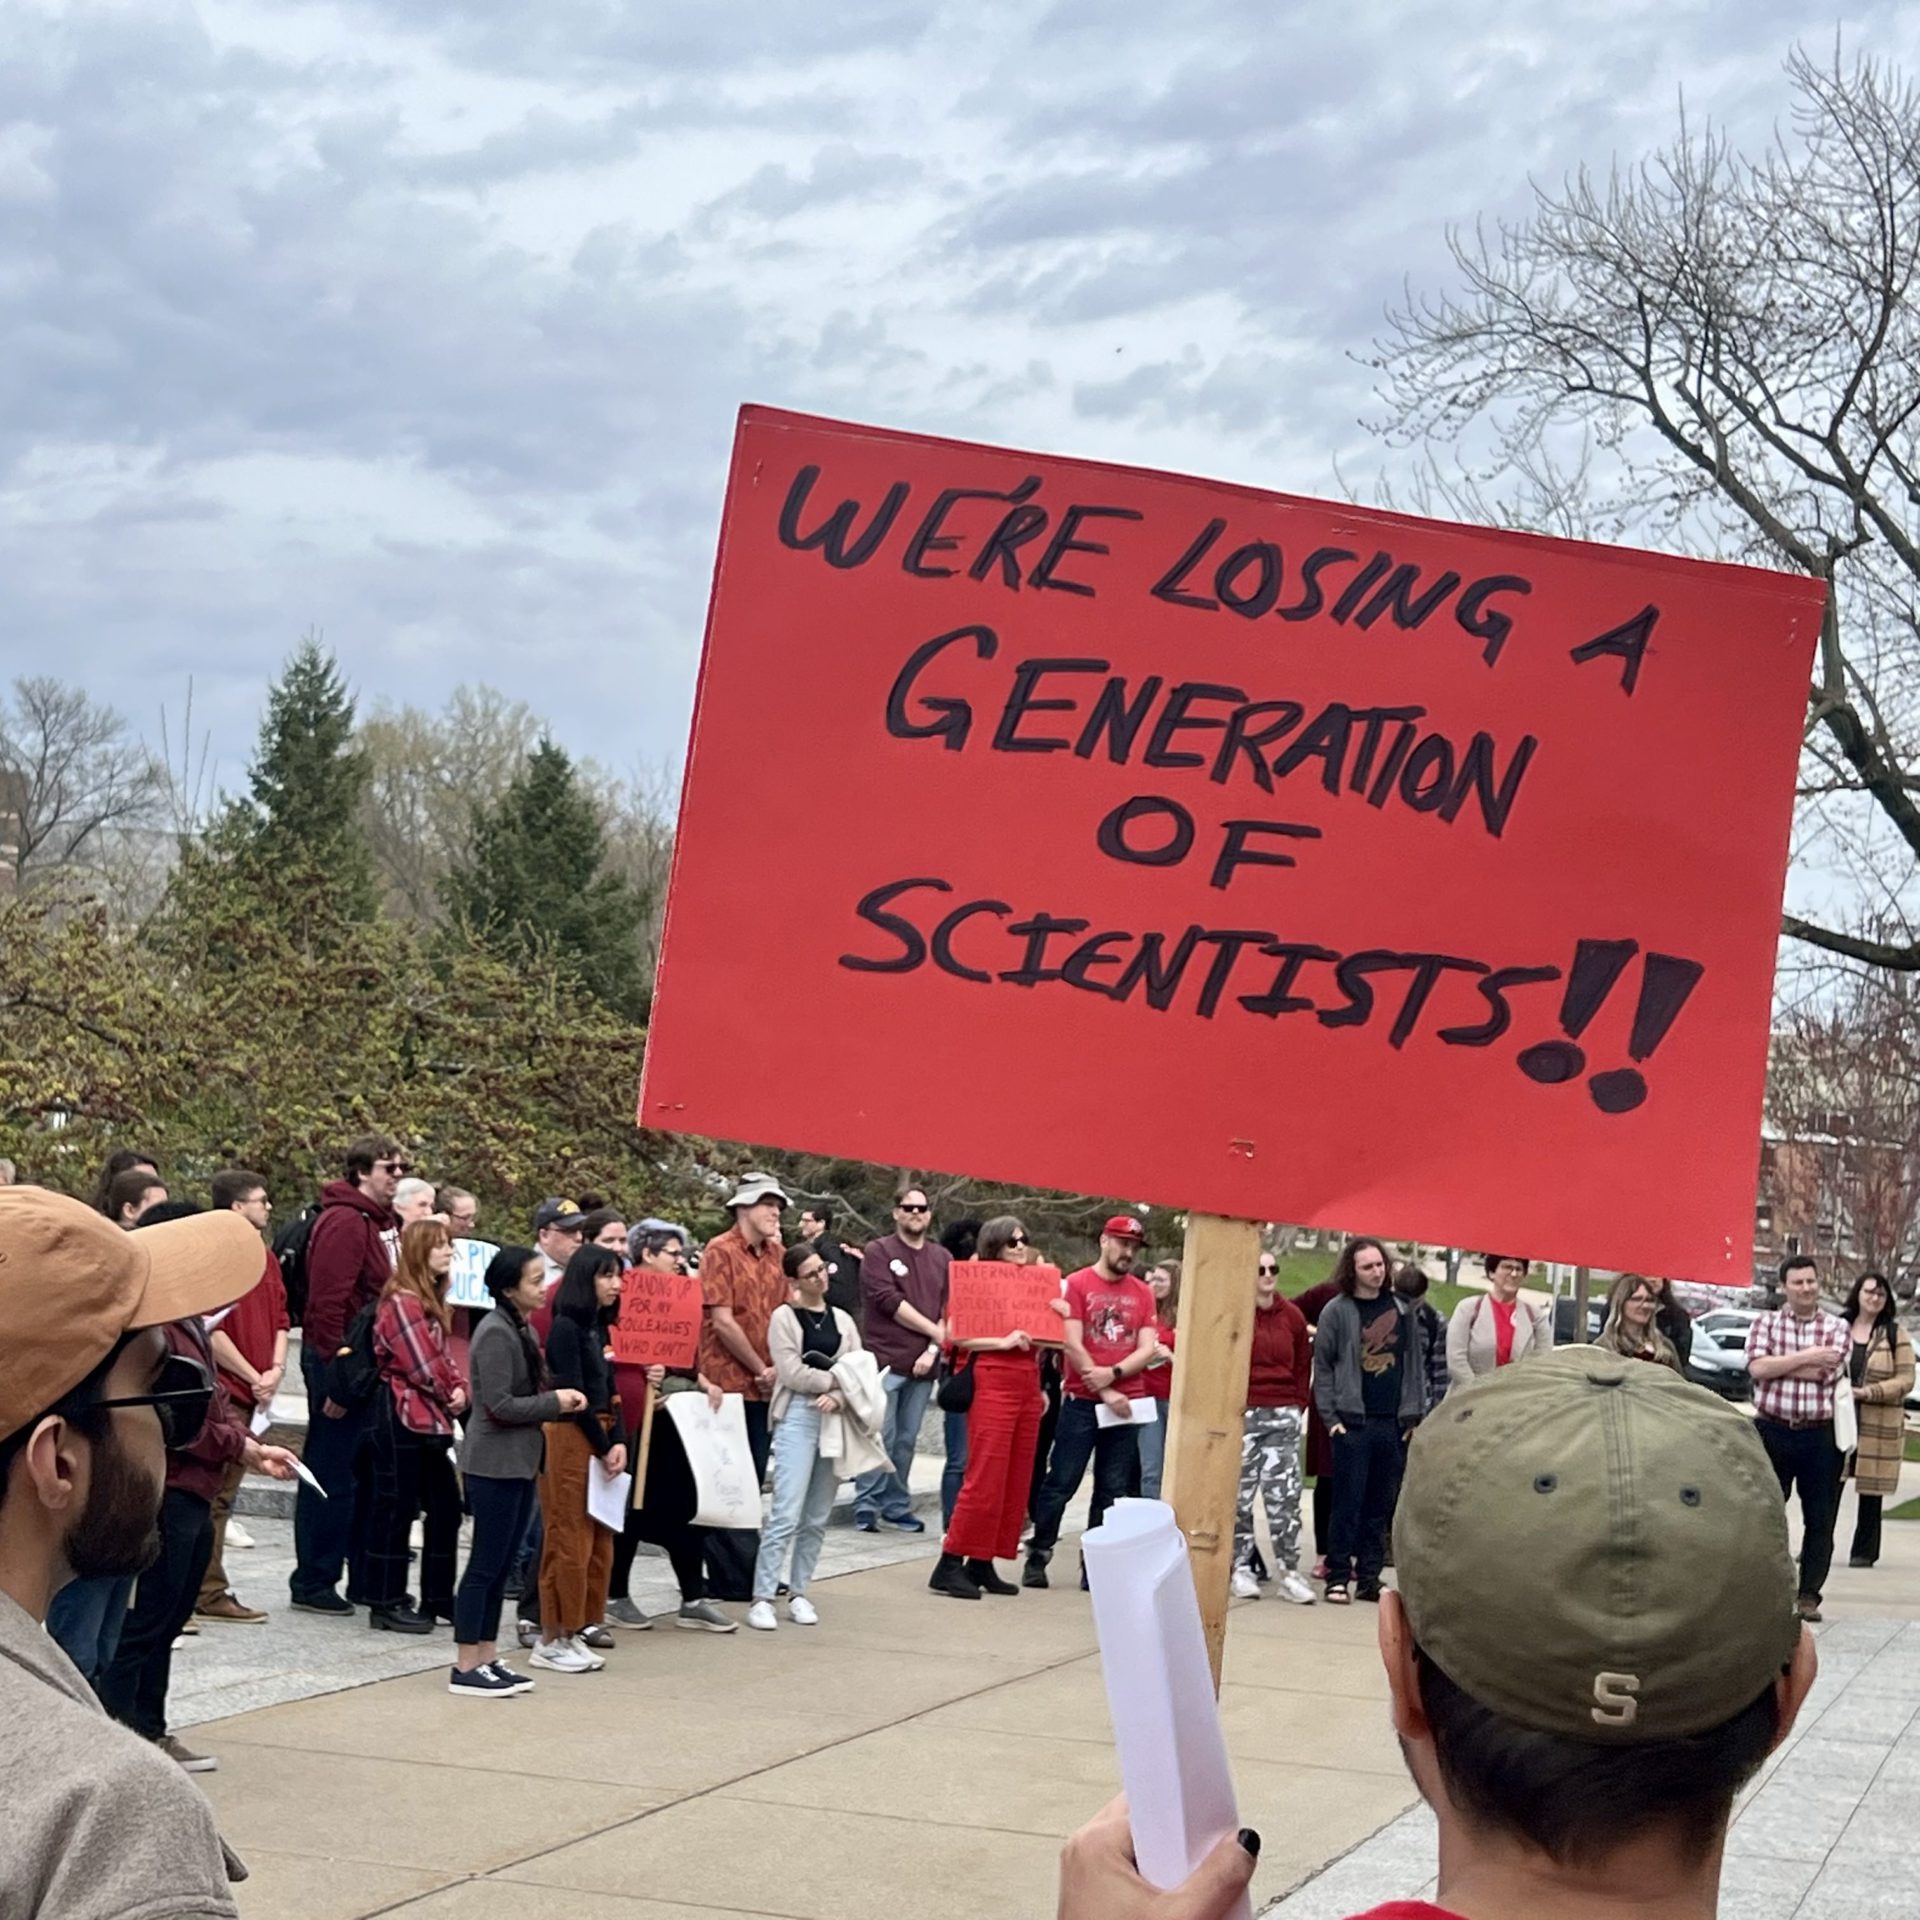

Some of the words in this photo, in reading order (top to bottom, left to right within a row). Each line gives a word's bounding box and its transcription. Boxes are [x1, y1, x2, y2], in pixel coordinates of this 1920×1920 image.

[778, 465, 1144, 598] WE'RE
[1150, 518, 1532, 668] LOSING
[1570, 603, 1661, 696] A
[885, 625, 1538, 838] GENERATION
[1097, 795, 1322, 890] OF
[838, 878, 1705, 1114] SCIENTISTS!!
[620, 1270, 673, 1298] STANDING
[676, 1280, 692, 1299] UP
[953, 1264, 1055, 1287] INTERNATIONAL
[629, 1297, 651, 1314] FOR
[656, 1301, 673, 1313] MY
[955, 1312, 1008, 1335] FIGHT
[619, 1338, 650, 1354] WHO
[1591, 1671, 1640, 1726] S
